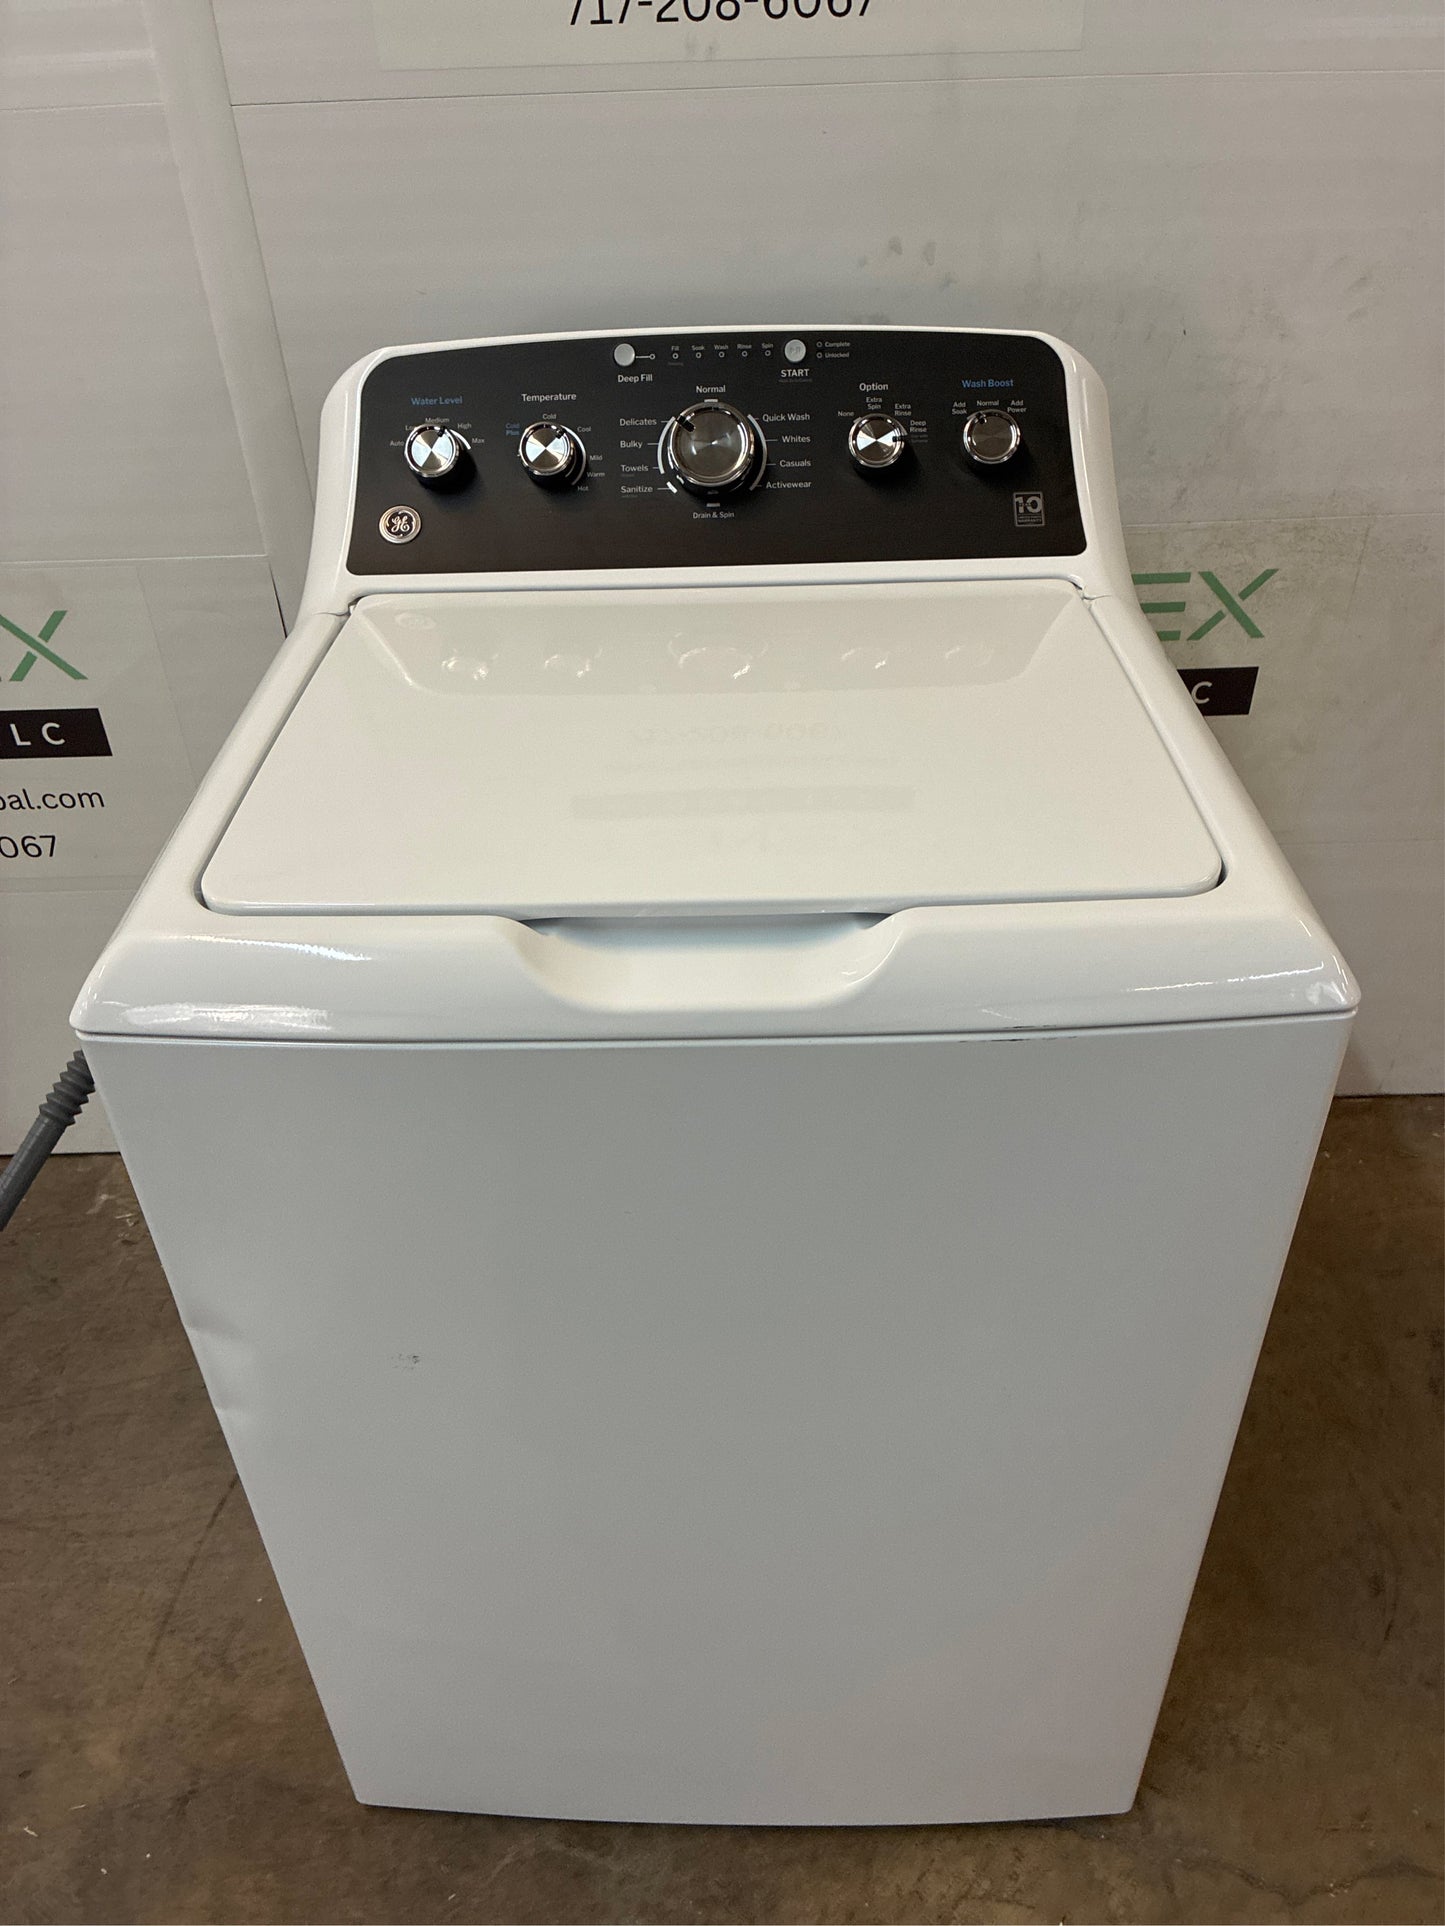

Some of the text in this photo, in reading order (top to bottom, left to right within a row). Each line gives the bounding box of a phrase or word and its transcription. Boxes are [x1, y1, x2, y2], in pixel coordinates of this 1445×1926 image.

[780, 368, 810, 378] START
[617, 373, 653, 383] Deep Fill
[859, 382, 889, 392] Option
[961, 379, 1014, 388] Wash Boost
[695, 384, 726, 393] Normal
[410, 395, 463, 406] Water Level
[521, 393, 577, 403] Temperature
[619, 418, 657, 426] Delicates
[762, 413, 786, 422] Quick
[457, 422, 472, 430] High
[781, 435, 811, 443] Whites
[619, 440, 643, 449] Bulky
[620, 464, 649, 472] Towels
[779, 459, 811, 468] Casuals
[620, 484, 653, 494] Sanitize
[765, 481, 812, 489] Activewear
[1014, 495, 1043, 513] 10
[692, 511, 711, 519] Drain
[719, 510, 735, 519] Spin
